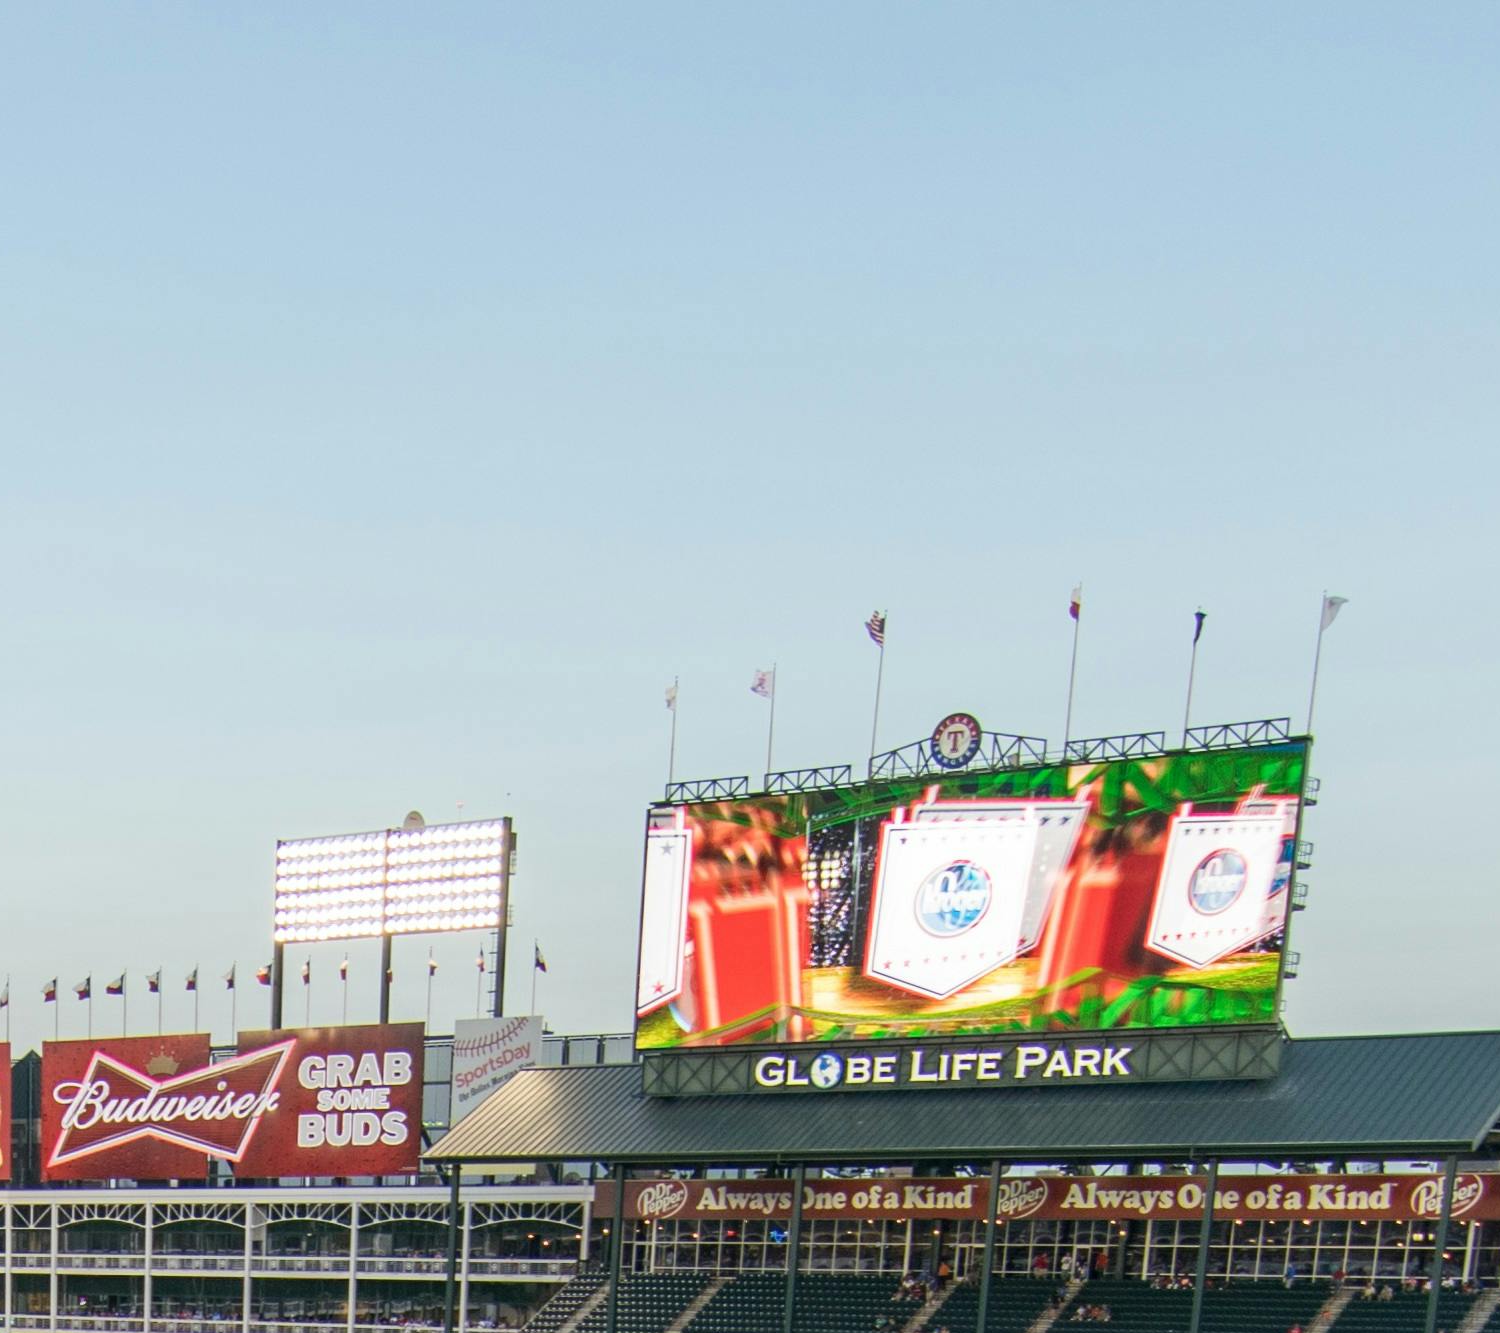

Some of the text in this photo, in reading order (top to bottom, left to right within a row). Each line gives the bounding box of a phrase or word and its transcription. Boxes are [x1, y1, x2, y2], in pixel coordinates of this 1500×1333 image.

[949, 730, 964, 753] T
[298, 1052, 412, 1089] GRAB
[456, 1042, 531, 1088] SportsDay
[755, 1046, 1132, 1089] GLOBE LIFE PARK
[53, 1079, 280, 1131] Budweiser
[317, 1088, 390, 1111] SOME
[296, 1111, 408, 1148] BUDS
[643, 1190, 686, 1216] Pepper
[656, 1182, 673, 1199] Dr
[696, 1187, 792, 1215] Always
[852, 1185, 879, 1210] of
[878, 1193, 899, 1210] a
[902, 1186, 973, 1209] Kind
[1013, 1180, 1031, 1197] Dr
[1061, 1182, 1392, 1214] Always Oe of a Kind
[1417, 1183, 1478, 1212] Peper
